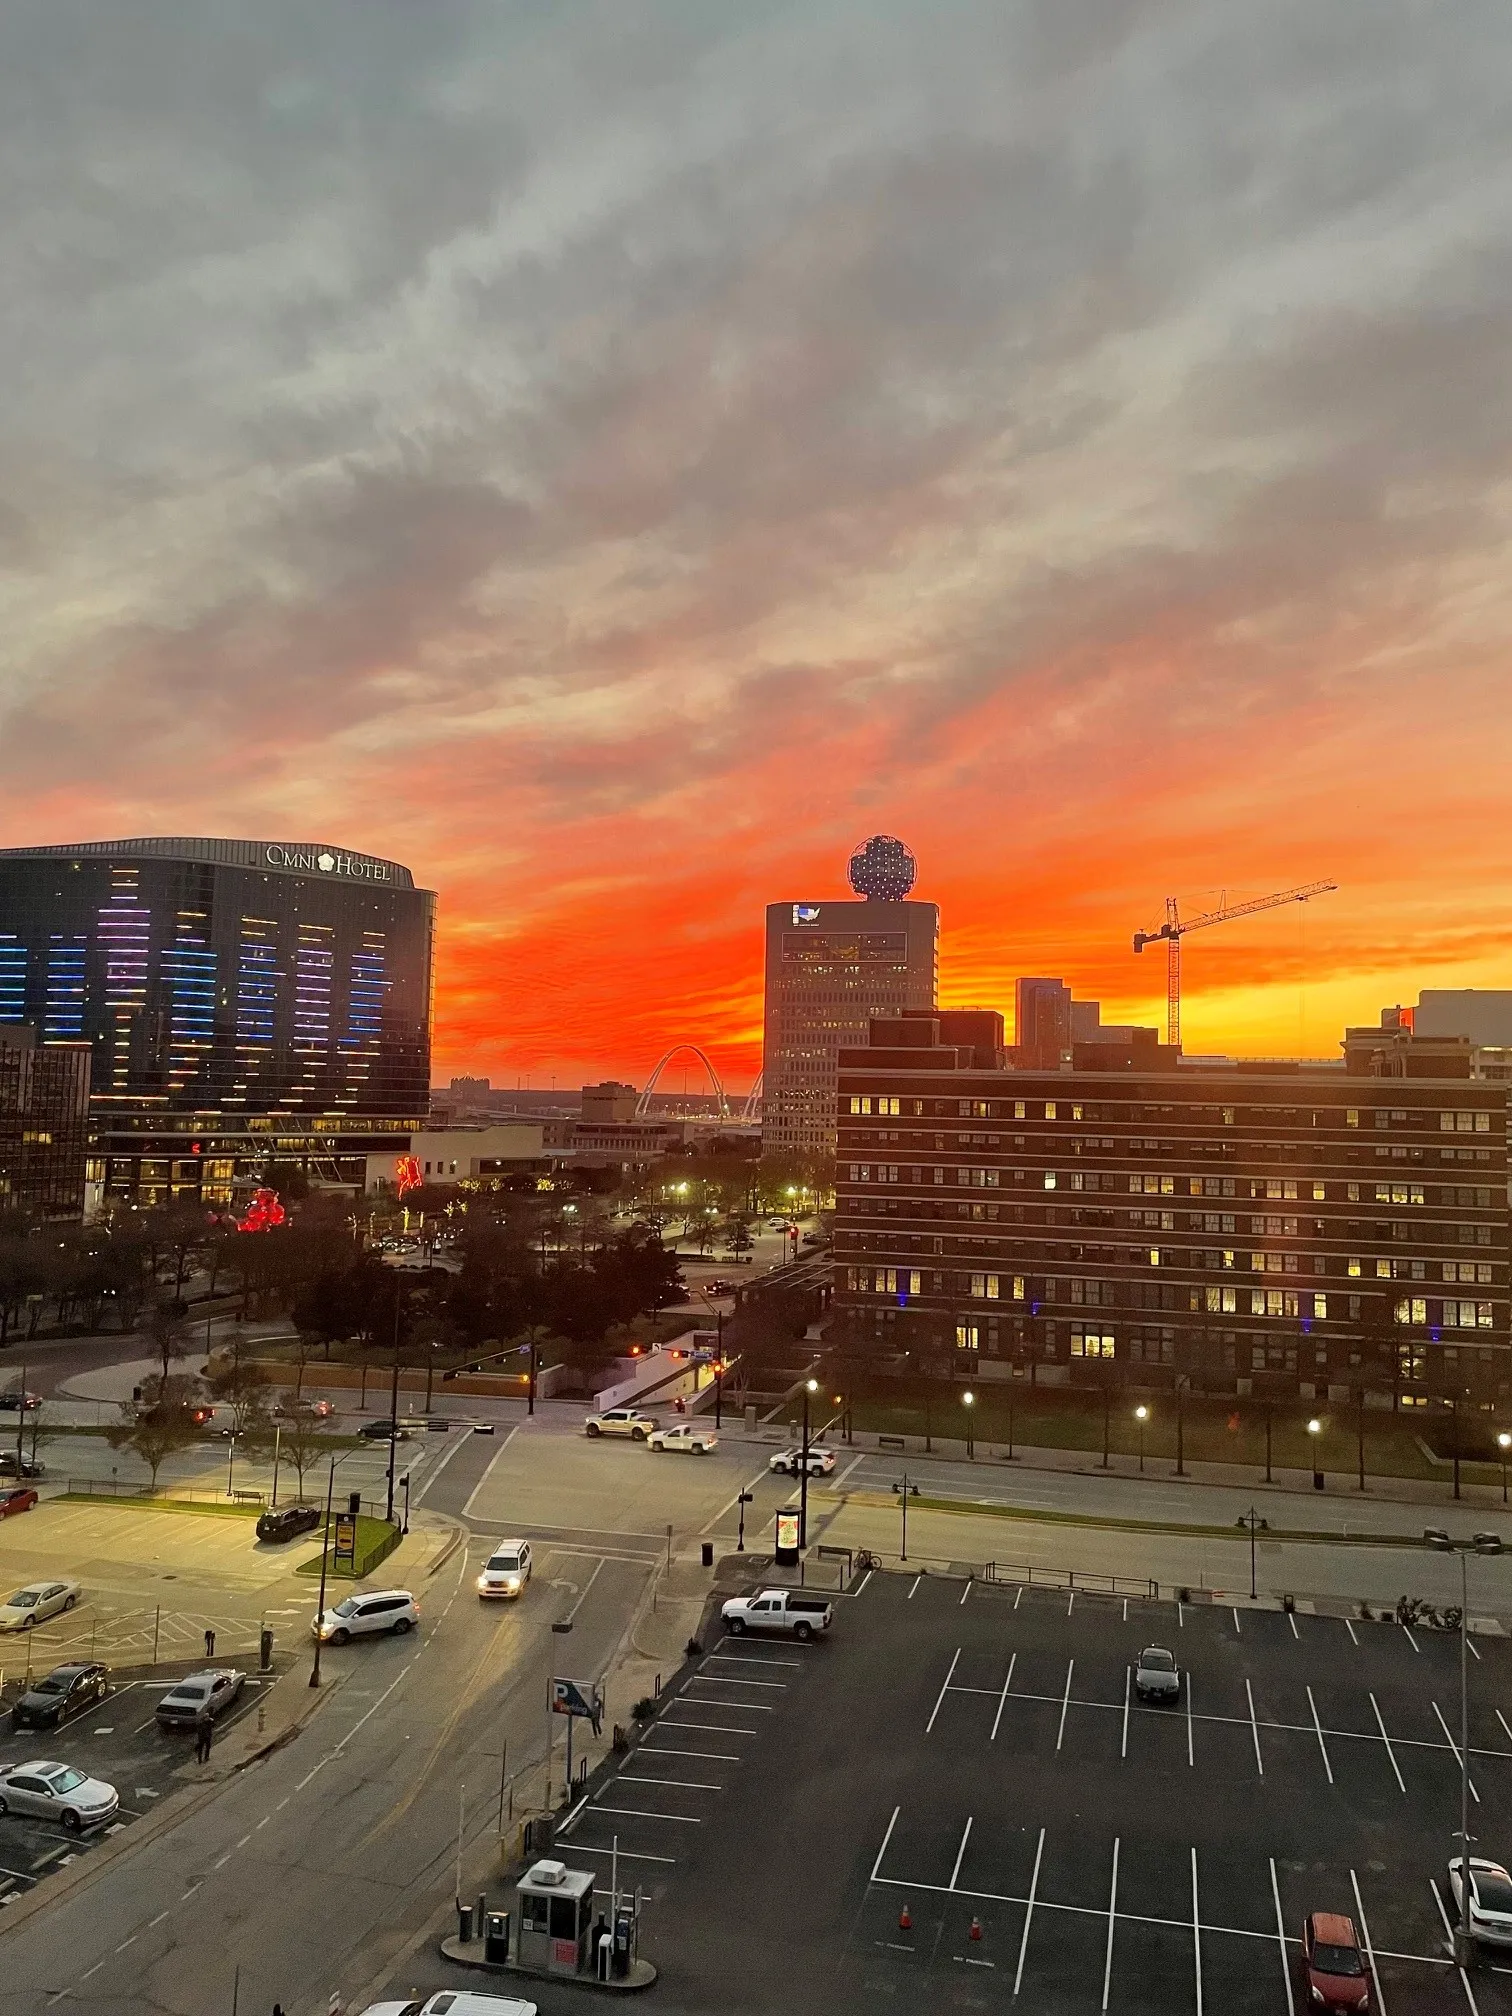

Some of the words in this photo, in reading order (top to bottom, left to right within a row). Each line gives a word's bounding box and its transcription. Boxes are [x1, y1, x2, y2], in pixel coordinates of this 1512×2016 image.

[266, 845, 315, 870] OMNI
[336, 855, 391, 881] HOTEL
[553, 1683, 568, 1702] P
